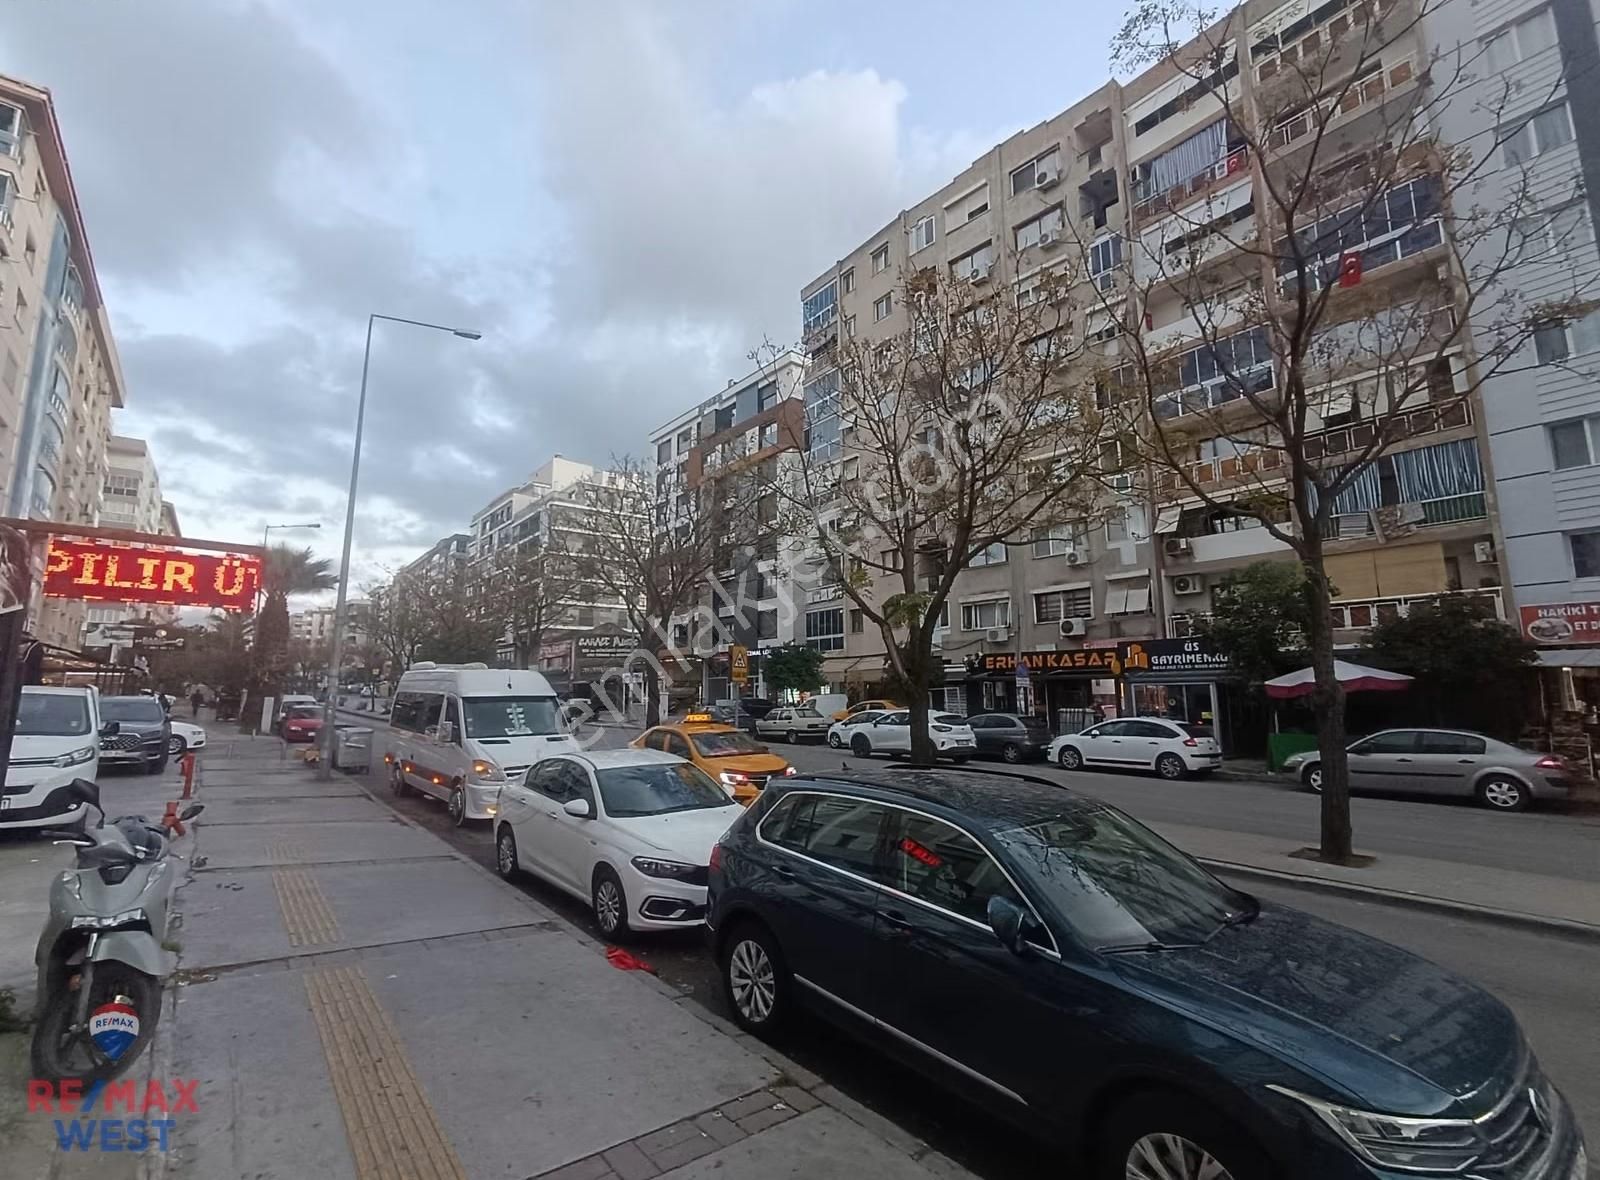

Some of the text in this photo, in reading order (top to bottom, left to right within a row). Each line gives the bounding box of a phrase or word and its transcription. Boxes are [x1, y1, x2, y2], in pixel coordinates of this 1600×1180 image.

[1537, 604, 1586, 617] HAKİKİ
[1574, 621, 1587, 631] ET
[1184, 641, 1200, 652] ÜS
[985, 654, 1043, 669] ERHAN
[1151, 653, 1229, 665] GAYRİMENKU
